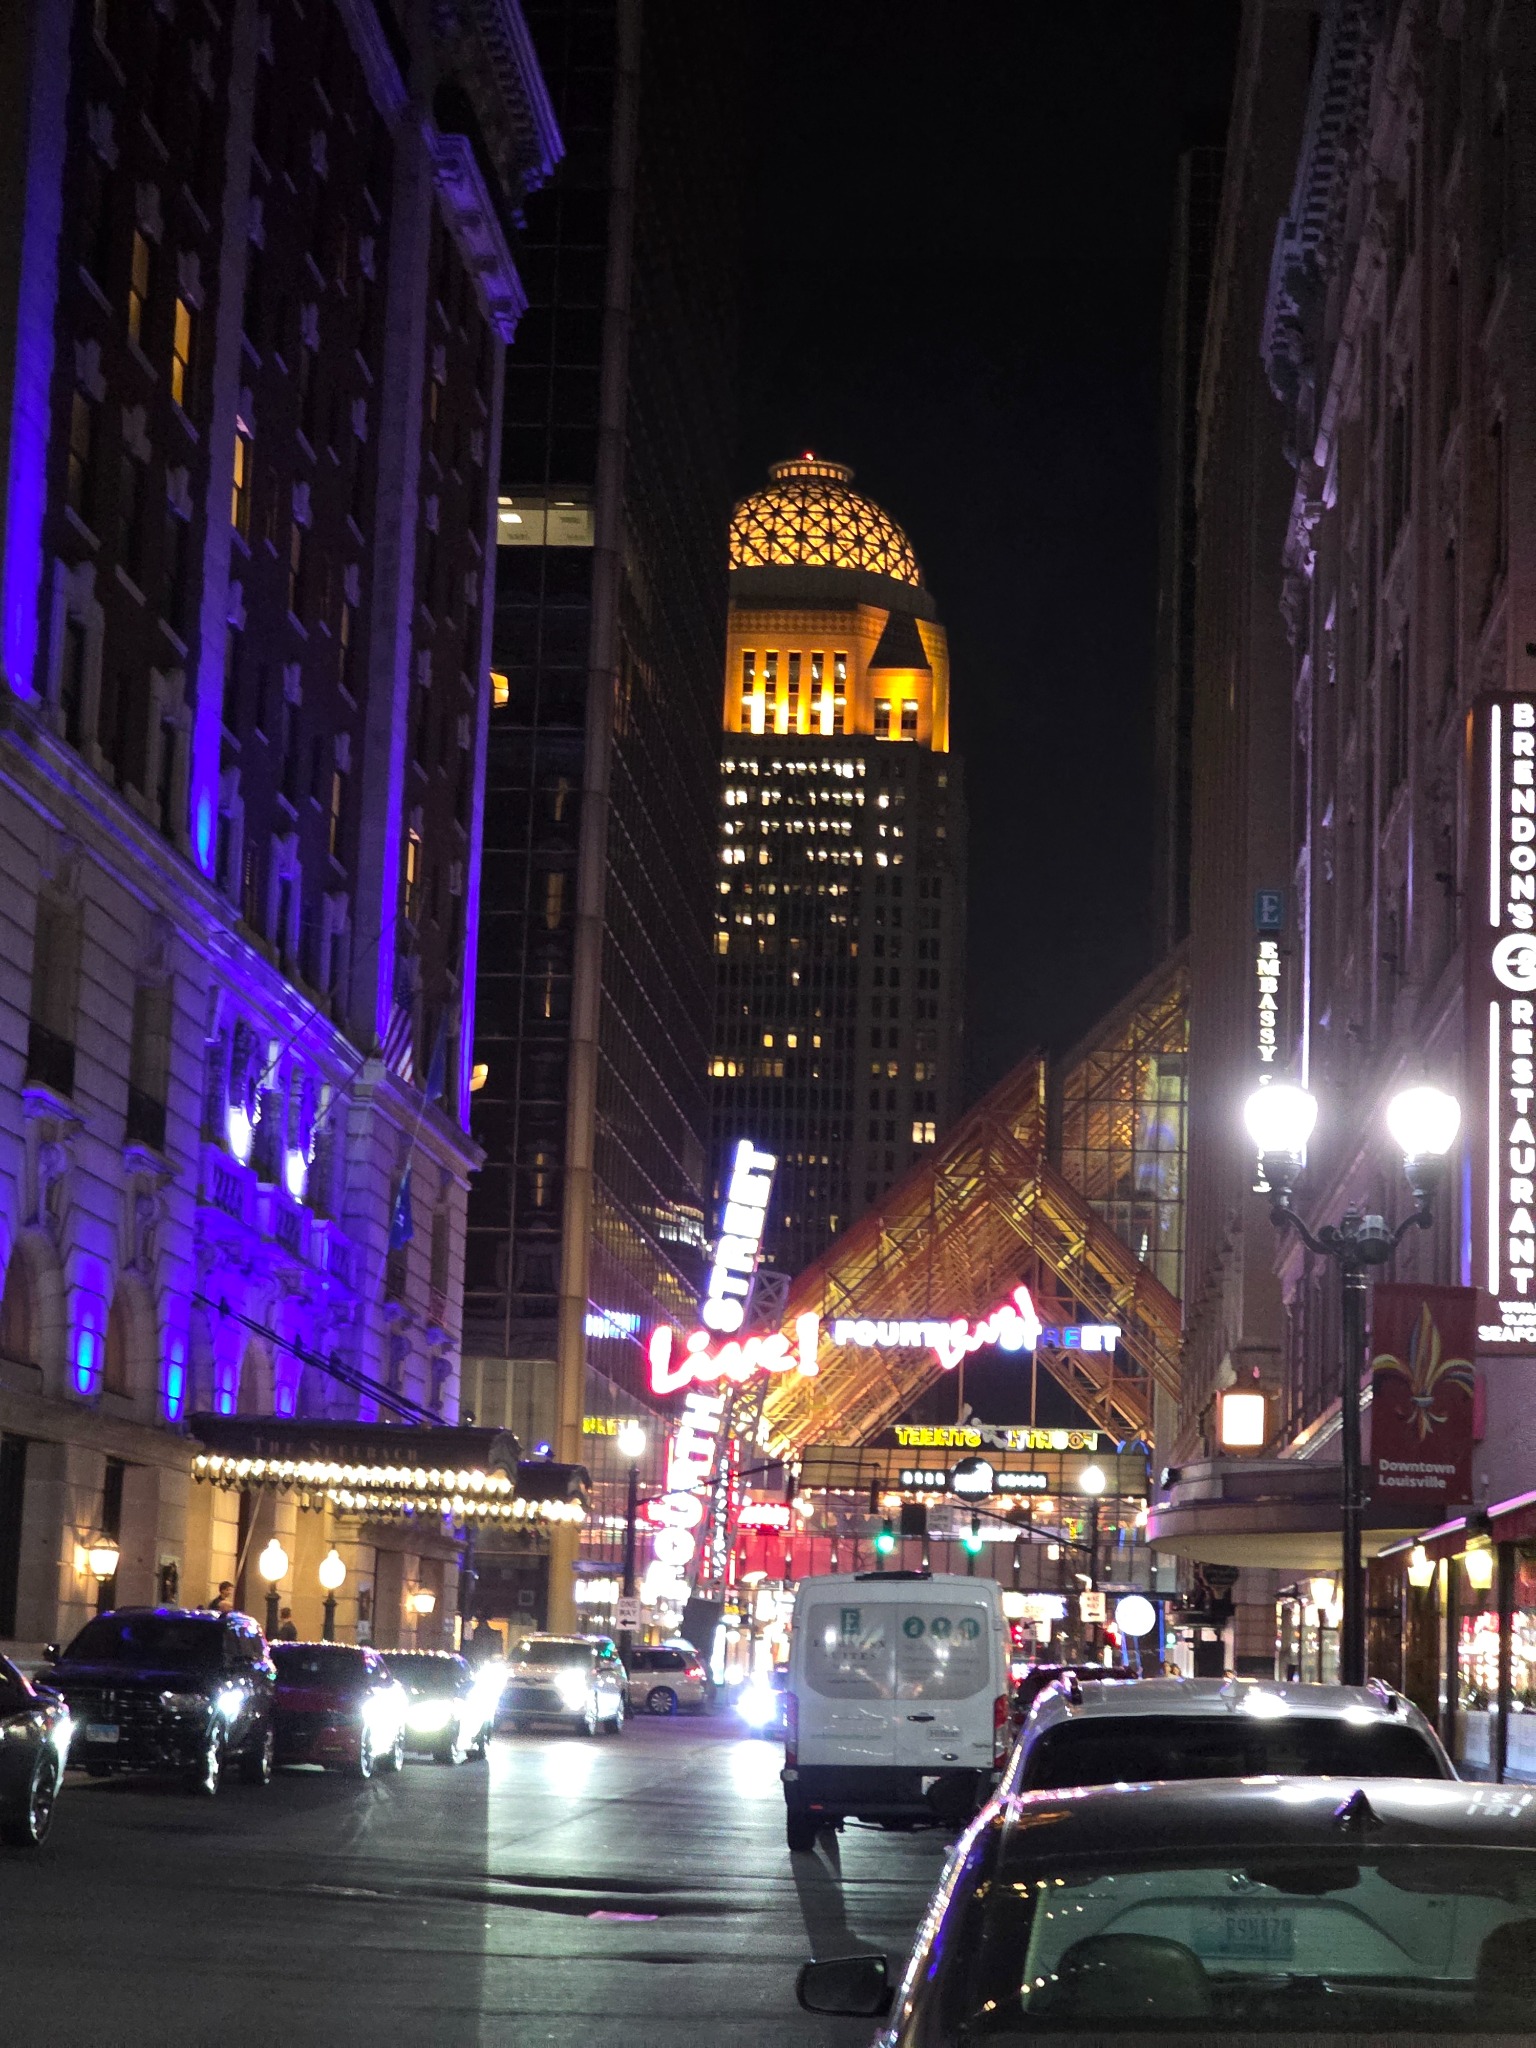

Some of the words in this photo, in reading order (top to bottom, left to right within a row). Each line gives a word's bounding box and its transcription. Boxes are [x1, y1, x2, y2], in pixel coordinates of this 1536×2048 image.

[1256, 941, 1281, 1062] EMBASSY
[1509, 1000, 1536, 1294] RESTAURANT
[703, 1139, 777, 1332] STREET
[648, 1312, 819, 1394] Live!
[1378, 1474, 1447, 1488] Louisville
[1379, 1458, 1456, 1474] Downtown
